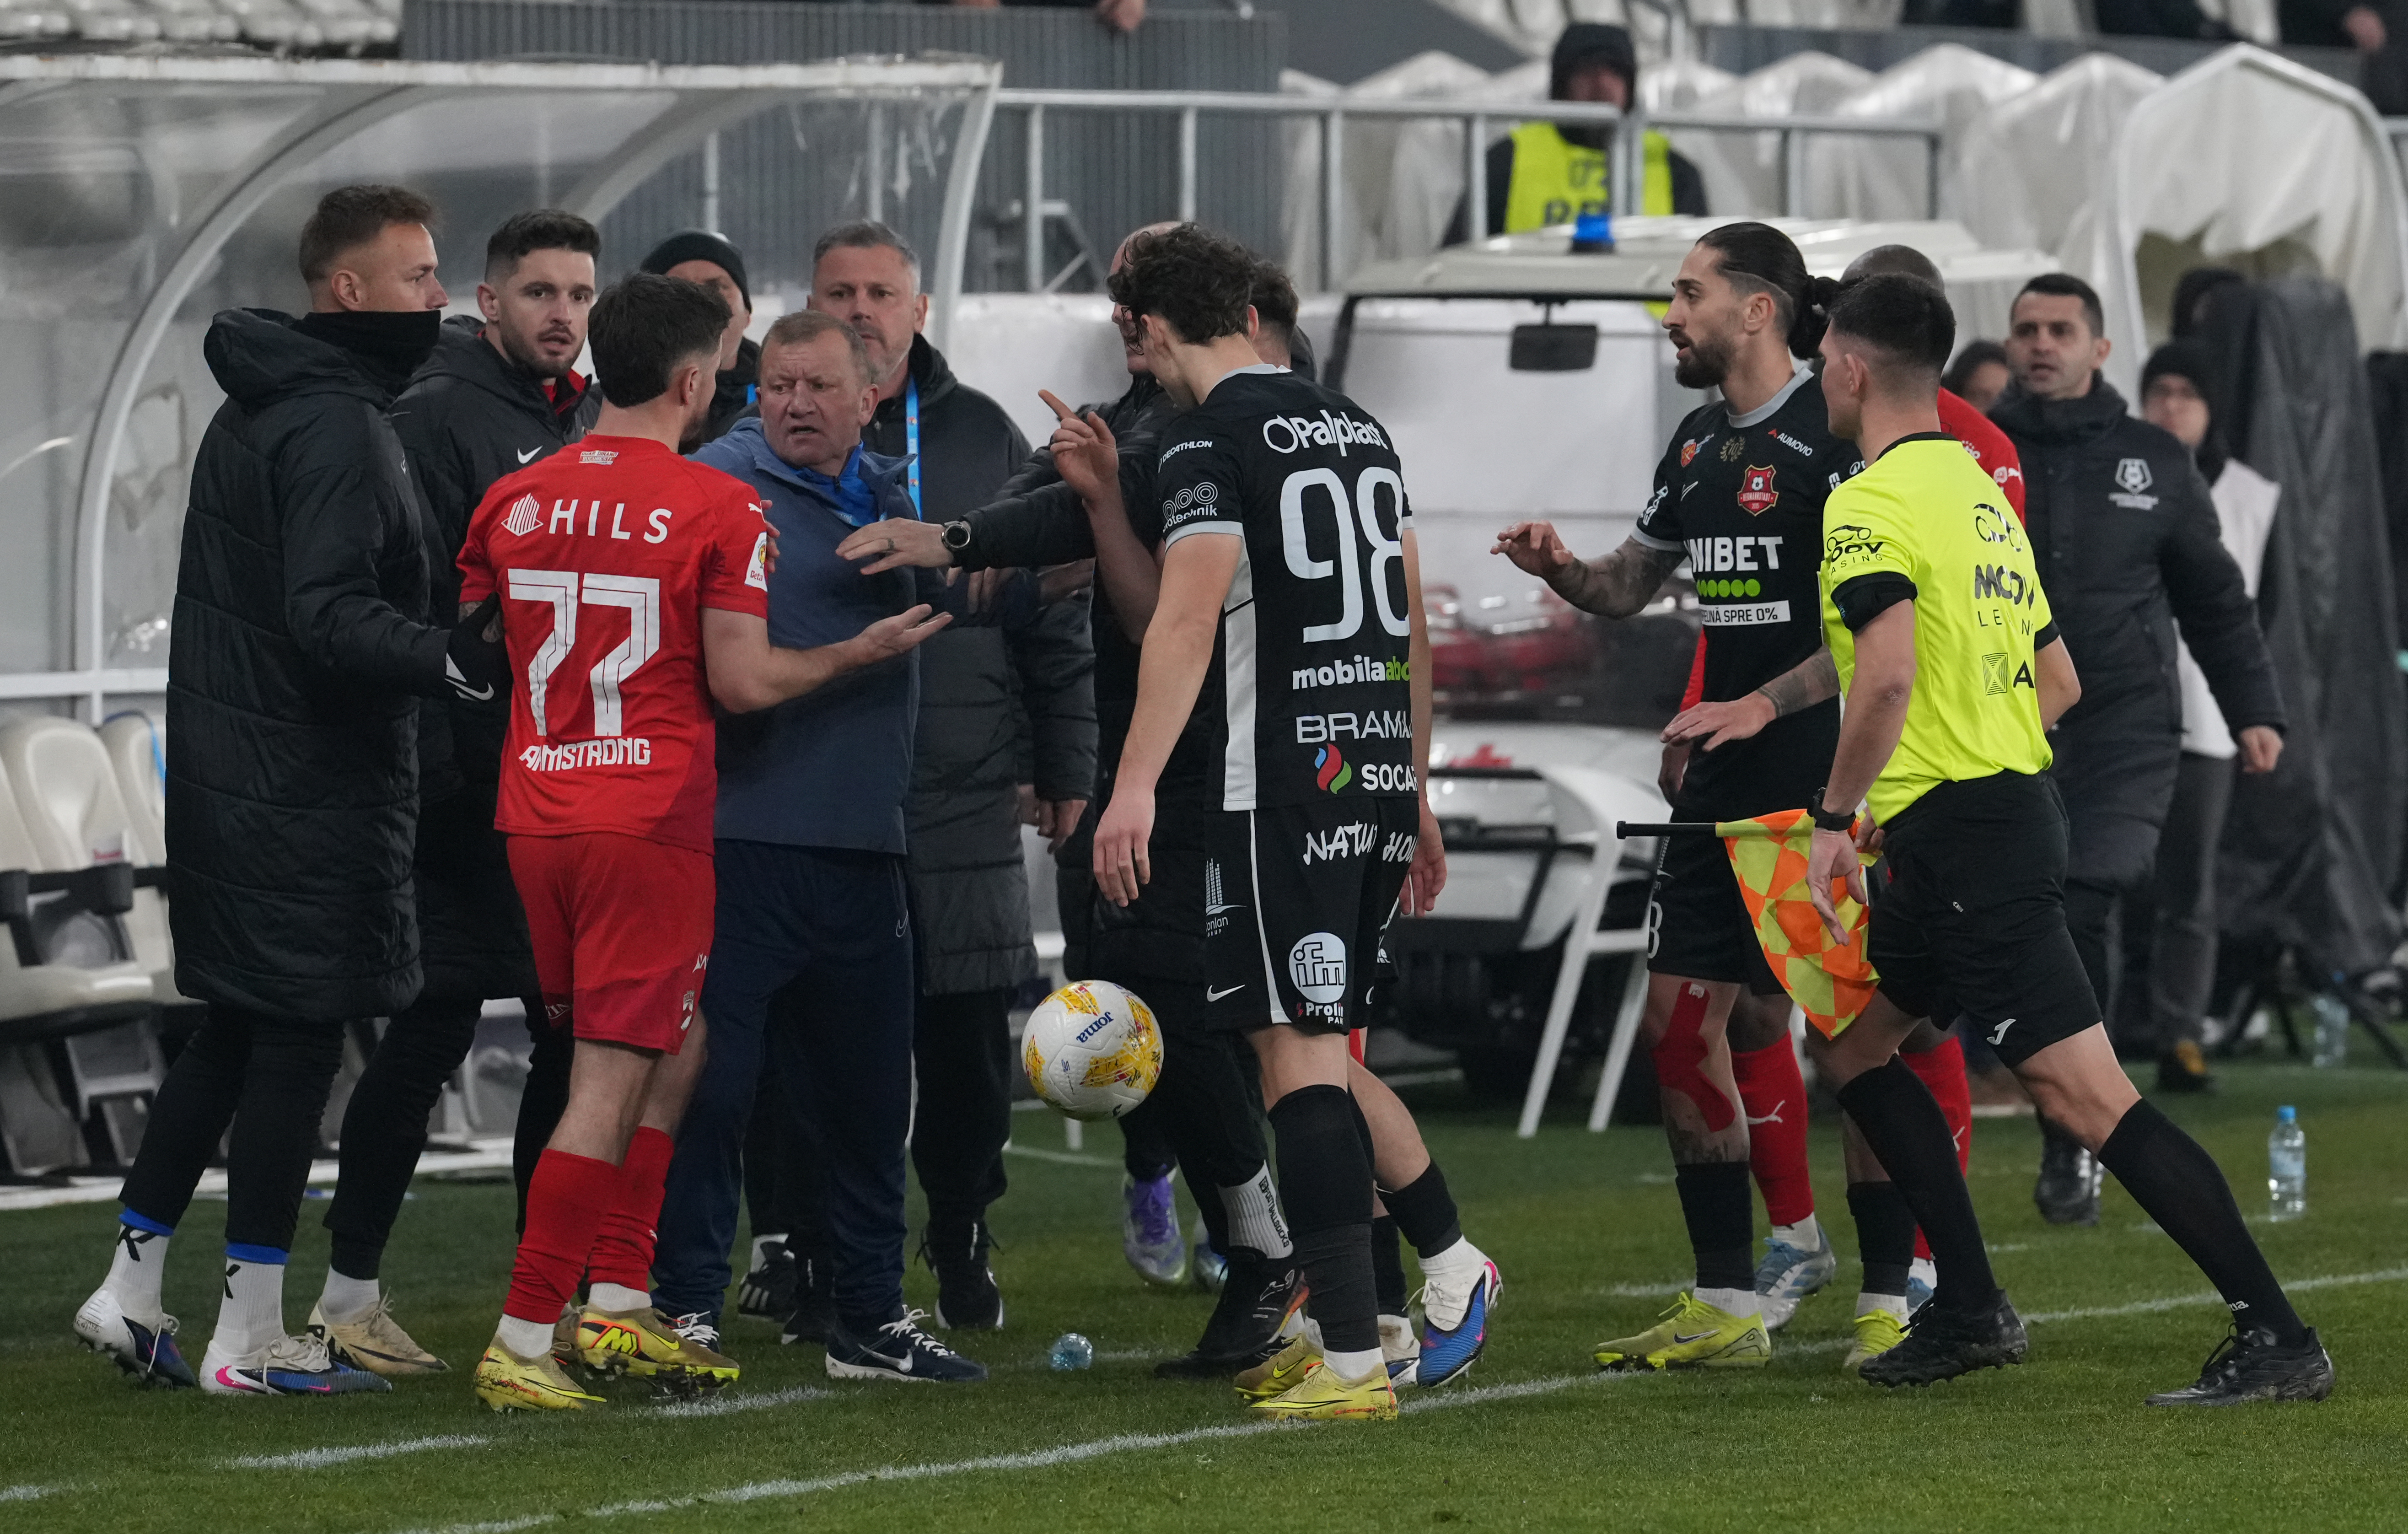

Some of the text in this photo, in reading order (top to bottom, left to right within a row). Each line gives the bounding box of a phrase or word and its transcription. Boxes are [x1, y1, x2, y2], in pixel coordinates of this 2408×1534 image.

[1162, 441, 1213, 463] DECATHLON
[1289, 409, 1389, 457] Palplast
[1777, 432, 1813, 457] AUMOVIO
[549, 499, 672, 544] HILS
[1280, 467, 1410, 643] 98
[1724, 609, 1753, 623] SPRE
[1756, 607, 1778, 621] 0%
[507, 568, 660, 736] 77
[1296, 710, 1412, 743] BRAMA
[1294, 942, 1345, 988] ifm
[1076, 1012, 1114, 1043] Joma
